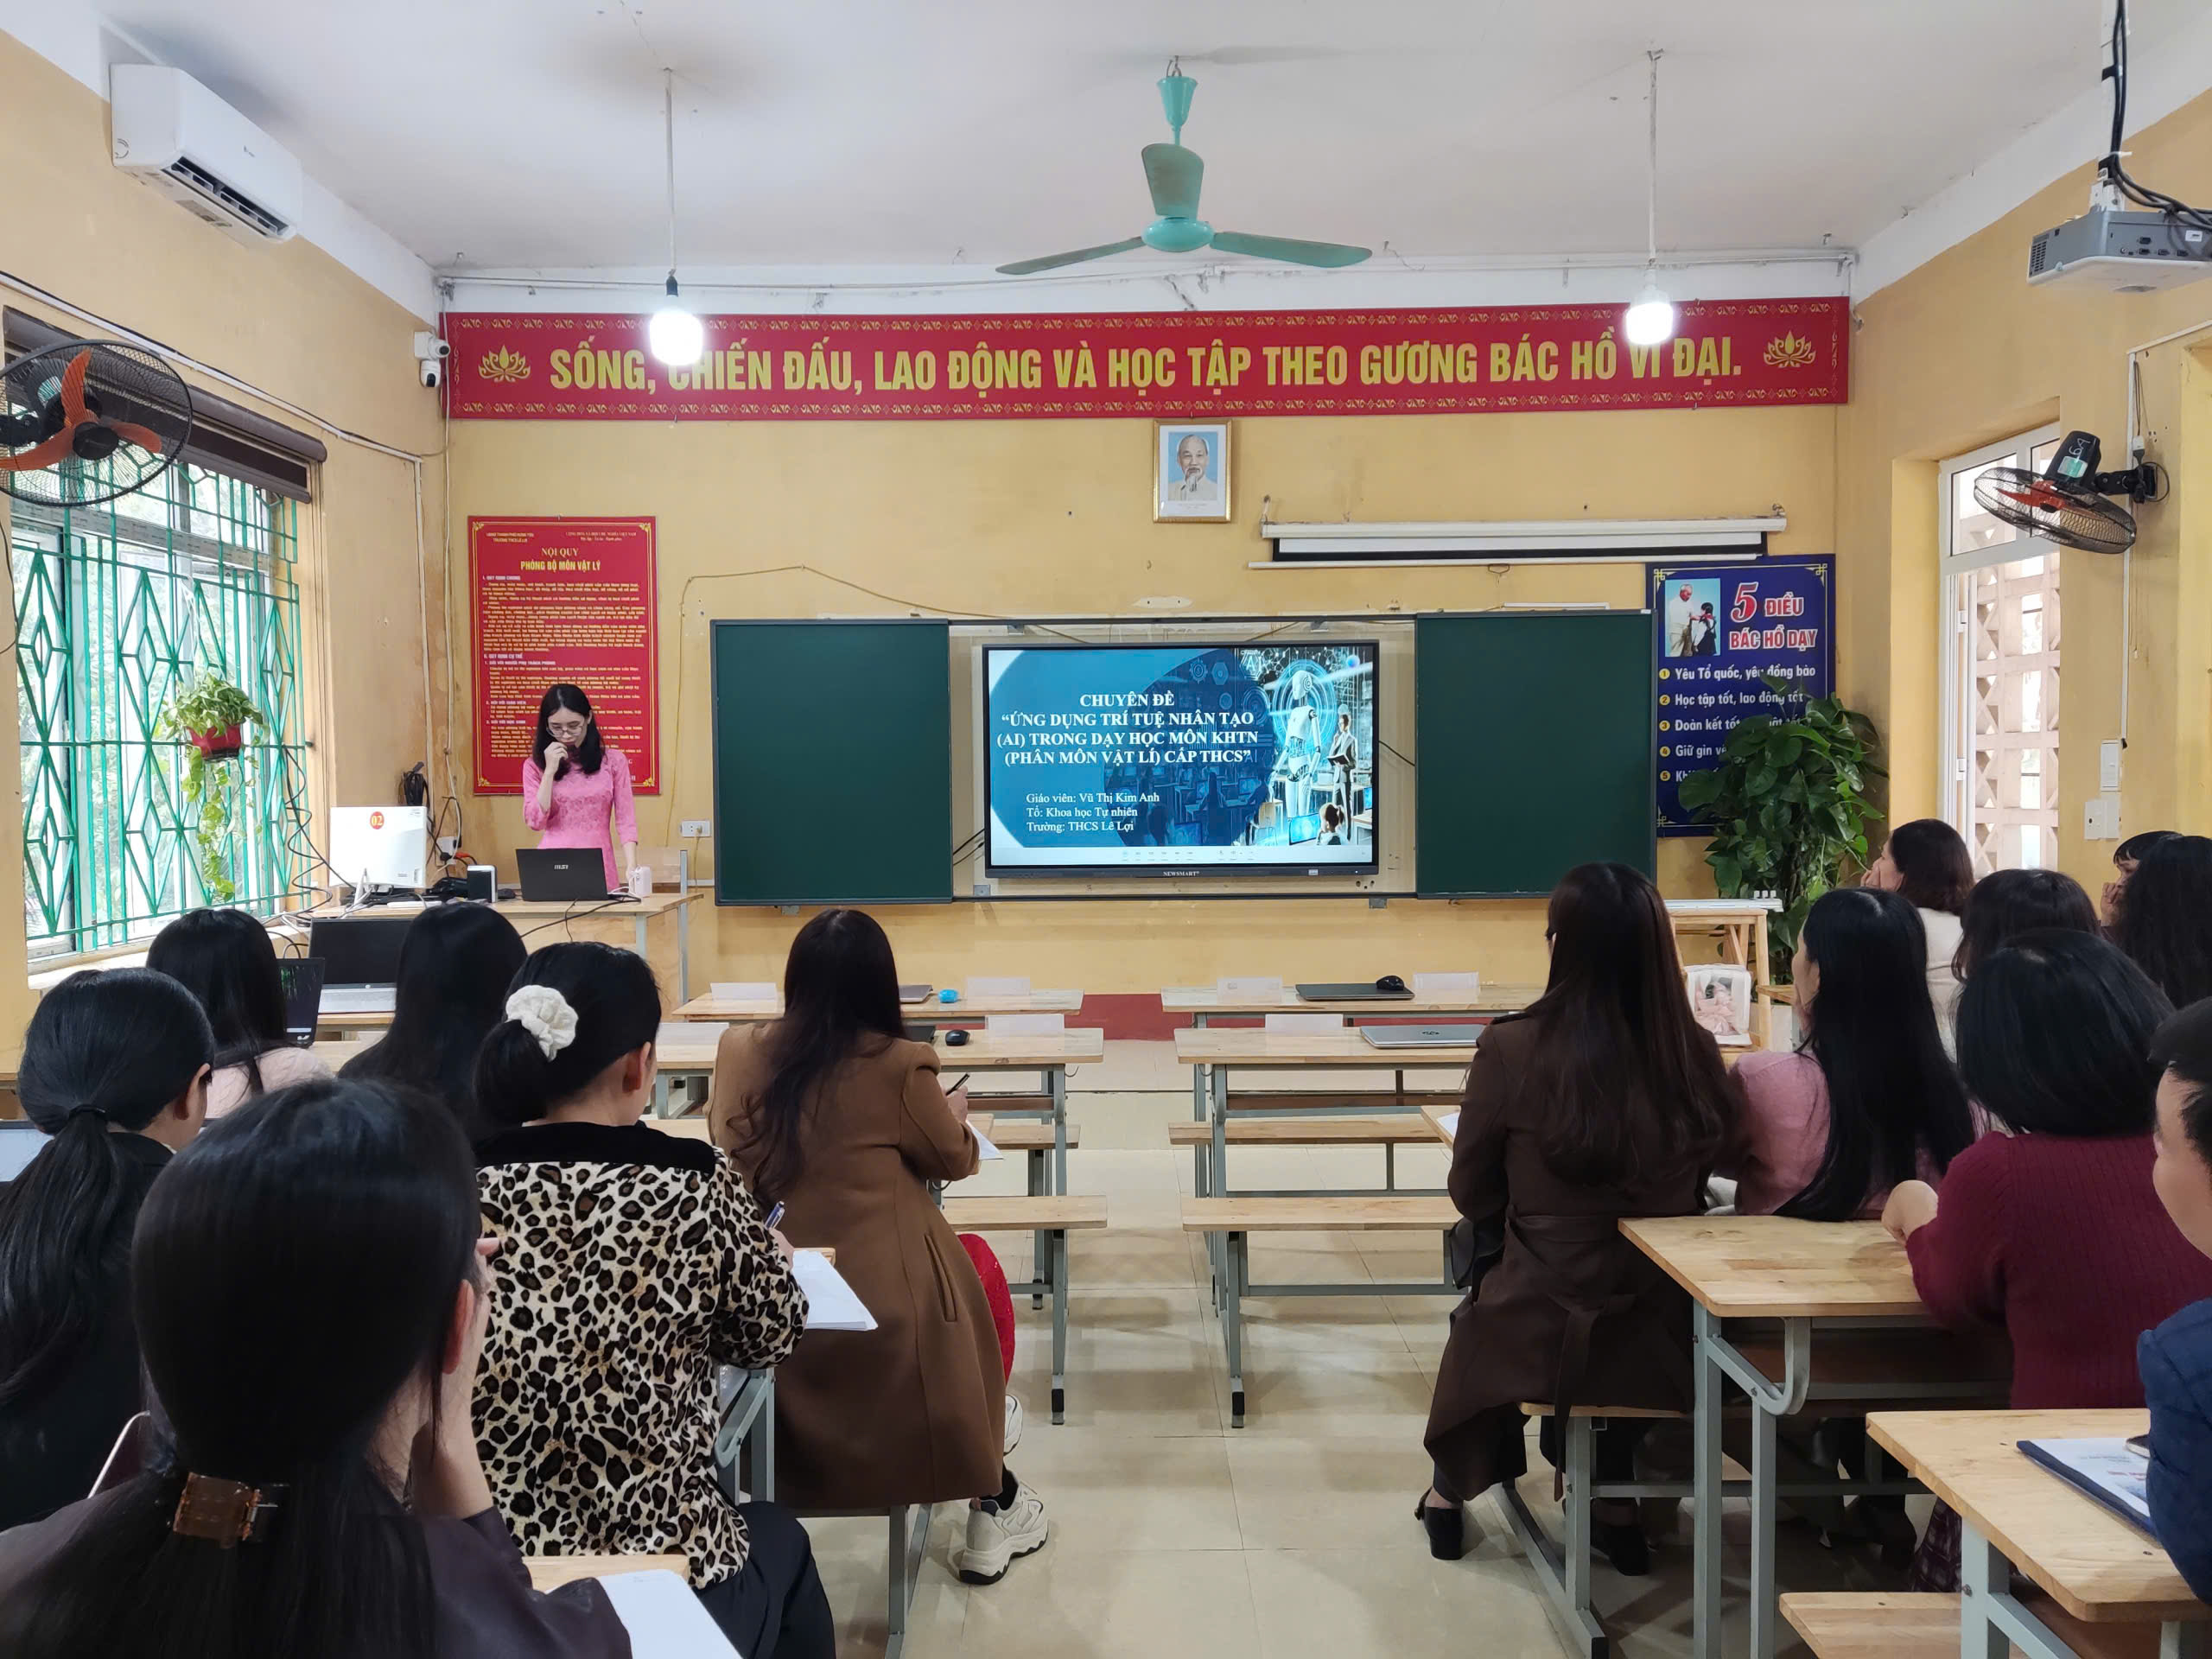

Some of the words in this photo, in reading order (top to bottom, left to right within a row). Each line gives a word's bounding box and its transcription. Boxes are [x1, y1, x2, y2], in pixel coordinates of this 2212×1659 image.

[550, 335, 655, 394] SỐNG,
[667, 338, 772, 391] CHIẾN
[783, 336, 862, 395] ĐẤU,
[874, 350, 936, 391] LAO
[947, 340, 1041, 398] ĐỘNG
[1052, 340, 1097, 388] VÀ
[1108, 347, 1176, 396] HỌC
[1186, 338, 1251, 395] TẬP
[1262, 346, 1348, 386] THEO
[1360, 340, 1478, 385] GƯƠNG
[1490, 334, 1559, 382] BÁC
[1571, 325, 1617, 380] HỒ
[1673, 336, 1742, 385] ĐẠI.
[541, 546, 557, 559] NỘI
[559, 546, 579, 559] QUY
[547, 559, 557, 573] BỘ
[558, 559, 576, 571] MÔN
[576, 559, 591, 573] VẬT
[1731, 581, 1759, 623] 5
[1764, 591, 1804, 617] ĐIỀU
[1729, 626, 1761, 650] BÁC
[1763, 624, 1785, 649] HỒ
[1787, 628, 1818, 652] DẠY
[1675, 667, 1695, 680] Yêu
[1697, 664, 1712, 679] Tổ
[1714, 664, 1743, 681] quốc,
[1767, 663, 1794, 680] đồng
[1796, 664, 1816, 677] bào
[1079, 690, 1149, 707] CHUYÊN
[1152, 690, 1175, 707] ĐỀ
[1675, 693, 1695, 709] Học
[1698, 692, 1716, 708] tập
[1718, 690, 1737, 705] tốt,
[1739, 692, 1756, 704] lao
[1758, 690, 1785, 707] động
[1050, 713, 1097, 729] DỤNG
[1100, 709, 1128, 726] TRÍ
[1132, 710, 1165, 728] TUỆ
[1168, 709, 1215, 726] NHÂN
[1218, 711, 1255, 728] TẠO
[1675, 718, 1703, 731] Đoàn
[1705, 715, 1723, 730] kết
[996, 733, 1026, 748] (AI)
[1029, 732, 1088, 746] TRONG
[1090, 732, 1126, 748] DẠY
[1128, 731, 1166, 748] HỌC
[1168, 728, 1208, 744] MÔN
[1211, 731, 1259, 744] KHTN
[1004, 748, 1055, 767] (PHÂN
[1058, 747, 1098, 764] MÔN
[1101, 748, 1135, 766] VẬT
[1138, 747, 1161, 766] LÍ)
[1164, 747, 1198, 763] CẤP
[1675, 744, 1694, 757] Giữ
[1026, 791, 1051, 804] Giáo
[1052, 792, 1077, 804] viên:
[1078, 791, 1094, 803] Vũ
[1096, 791, 1113, 804] Thị
[1115, 791, 1137, 803] Kim
[1139, 791, 1160, 803] Anh
[1026, 804, 1044, 817] Tổ:
[1046, 807, 1072, 817] Khoa
[1074, 806, 1092, 819] học
[1094, 806, 1109, 819] Tự
[1110, 807, 1138, 817] nhiên
[371, 815, 384, 827] 02
[1026, 821, 1065, 834] Trường:
[1068, 821, 1099, 831] THCS
[1101, 820, 1115, 831] Lê
[1116, 820, 1135, 833] Lợi
